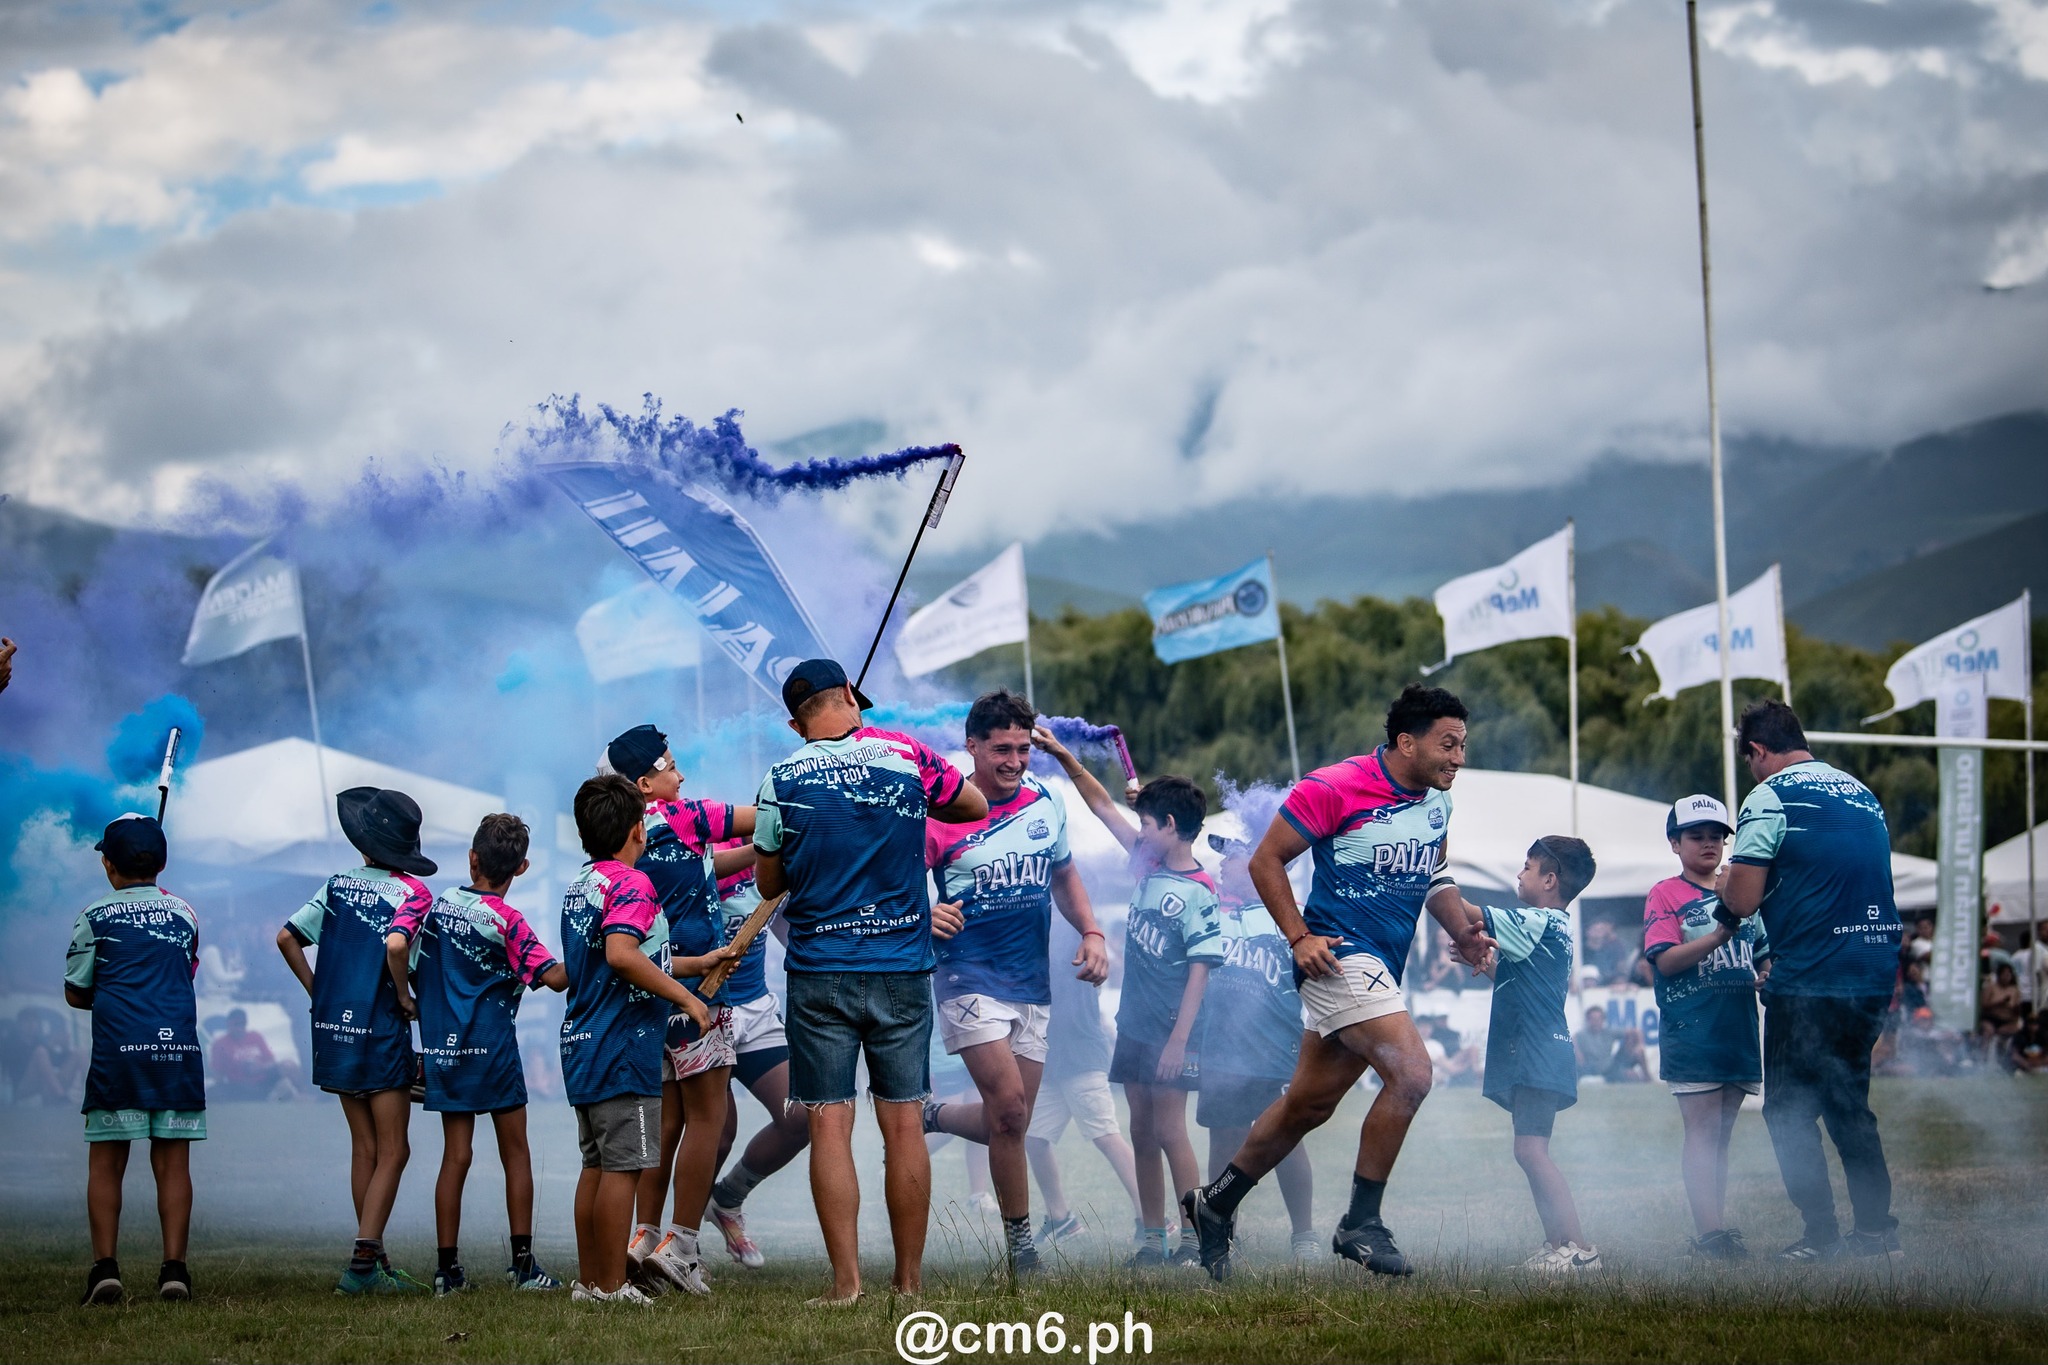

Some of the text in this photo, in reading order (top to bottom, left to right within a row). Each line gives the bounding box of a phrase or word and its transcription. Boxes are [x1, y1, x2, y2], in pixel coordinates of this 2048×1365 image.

[792, 745, 875, 777] UNIVERSITARIO
[825, 764, 871, 785] LA 2014
[1823, 783, 1863, 794] LA 2014
[1692, 798, 1717, 811] PALAU
[971, 851, 1051, 896] PALAU
[334, 876, 393, 895] UNIVERSITARIO
[348, 890, 380, 905] LA 2014
[104, 900, 179, 918] UNIVERSITARIO
[132, 911, 173, 925] LA 2014
[864, 913, 920, 927] YUANFEN
[1687, 914, 1708, 924] SEVEN
[443, 916, 471, 935] LA 2014
[1833, 924, 1869, 934] GRUPO
[1697, 935, 1755, 978] PALA
[314, 1021, 373, 1035] GRUPO YUANFN
[119, 1043, 200, 1052] GRUPO YUANFEN
[423, 1047, 488, 1057] RUPO YUANFEN
[638, 1105, 648, 1158] UNDER ARMOUR
